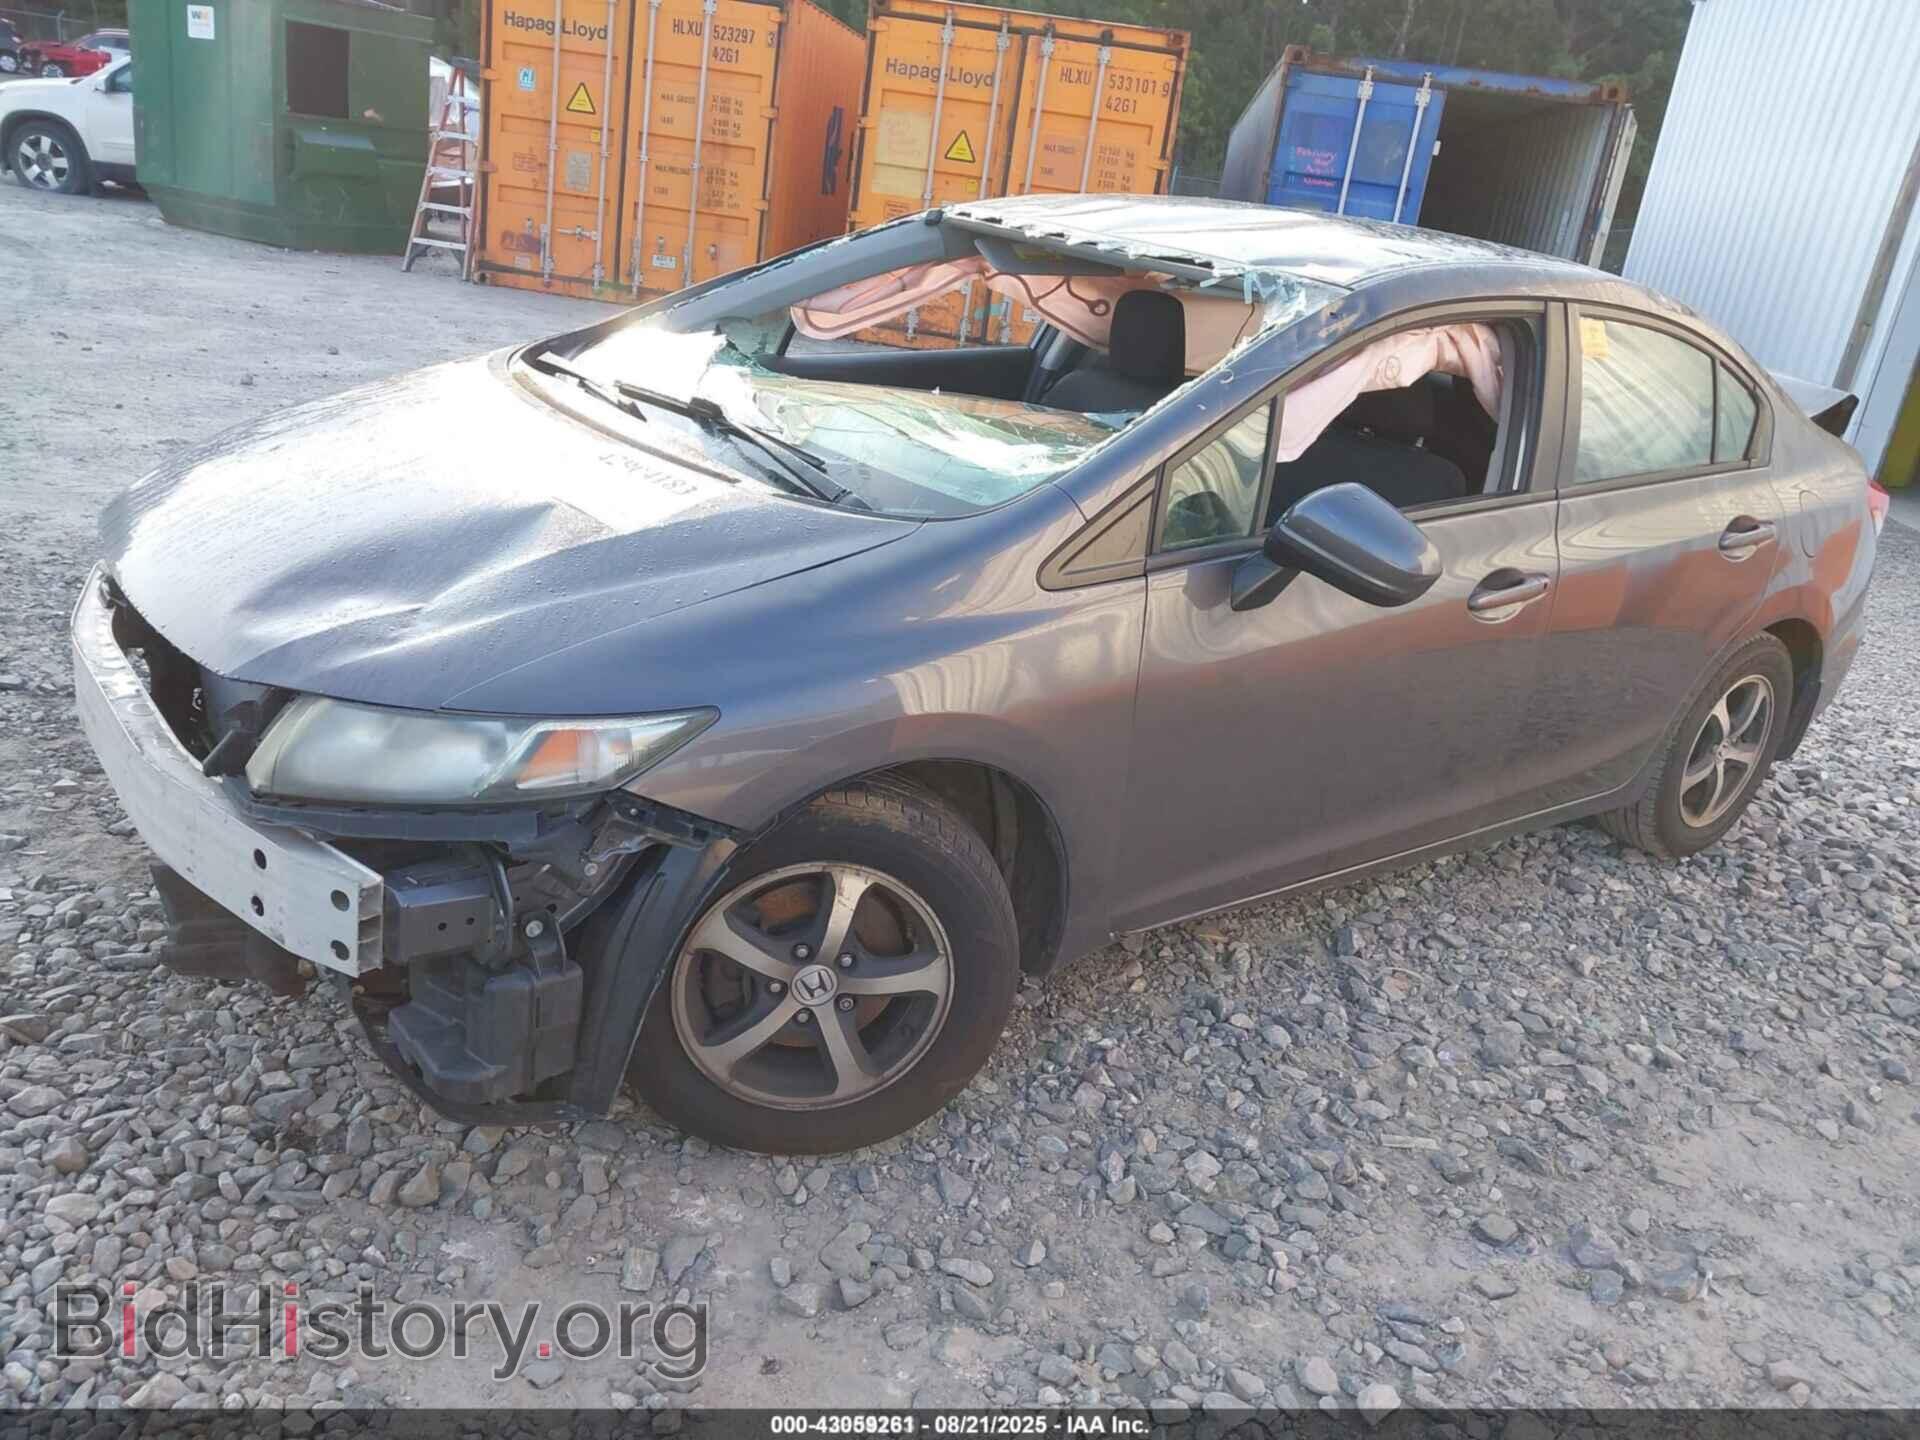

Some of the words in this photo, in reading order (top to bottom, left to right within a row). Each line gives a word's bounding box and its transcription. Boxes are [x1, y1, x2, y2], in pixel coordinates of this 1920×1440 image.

[503, 10, 608, 42] HapagLloyd
[672, 18, 702, 36] HLXU
[712, 26, 755, 45] 523297
[767, 33, 775, 48] 3
[1060, 66, 1092, 86] HLXU
[1109, 74, 1157, 96] 533101
[1106, 96, 1138, 114] 42G1
